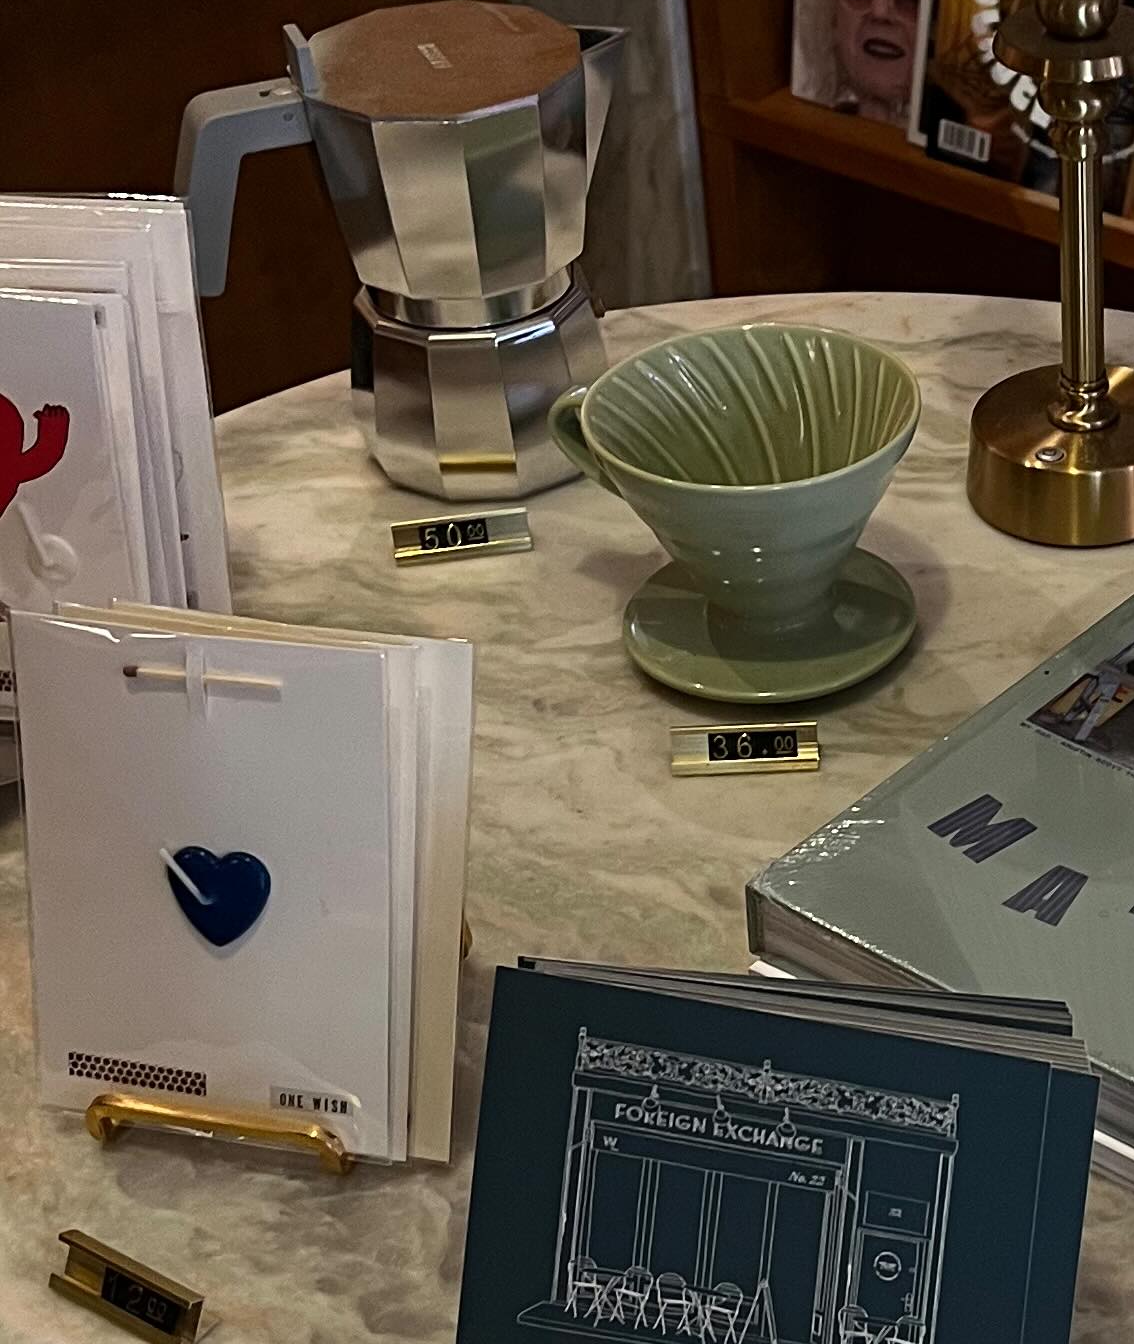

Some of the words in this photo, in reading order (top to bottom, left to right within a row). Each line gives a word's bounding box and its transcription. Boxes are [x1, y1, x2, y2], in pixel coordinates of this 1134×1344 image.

[279, 1091, 304, 1111] ONE
[312, 1096, 349, 1116] WISH
[613, 1101, 707, 1136] FOREIGN
[712, 1121, 825, 1157] EXCHANGE
